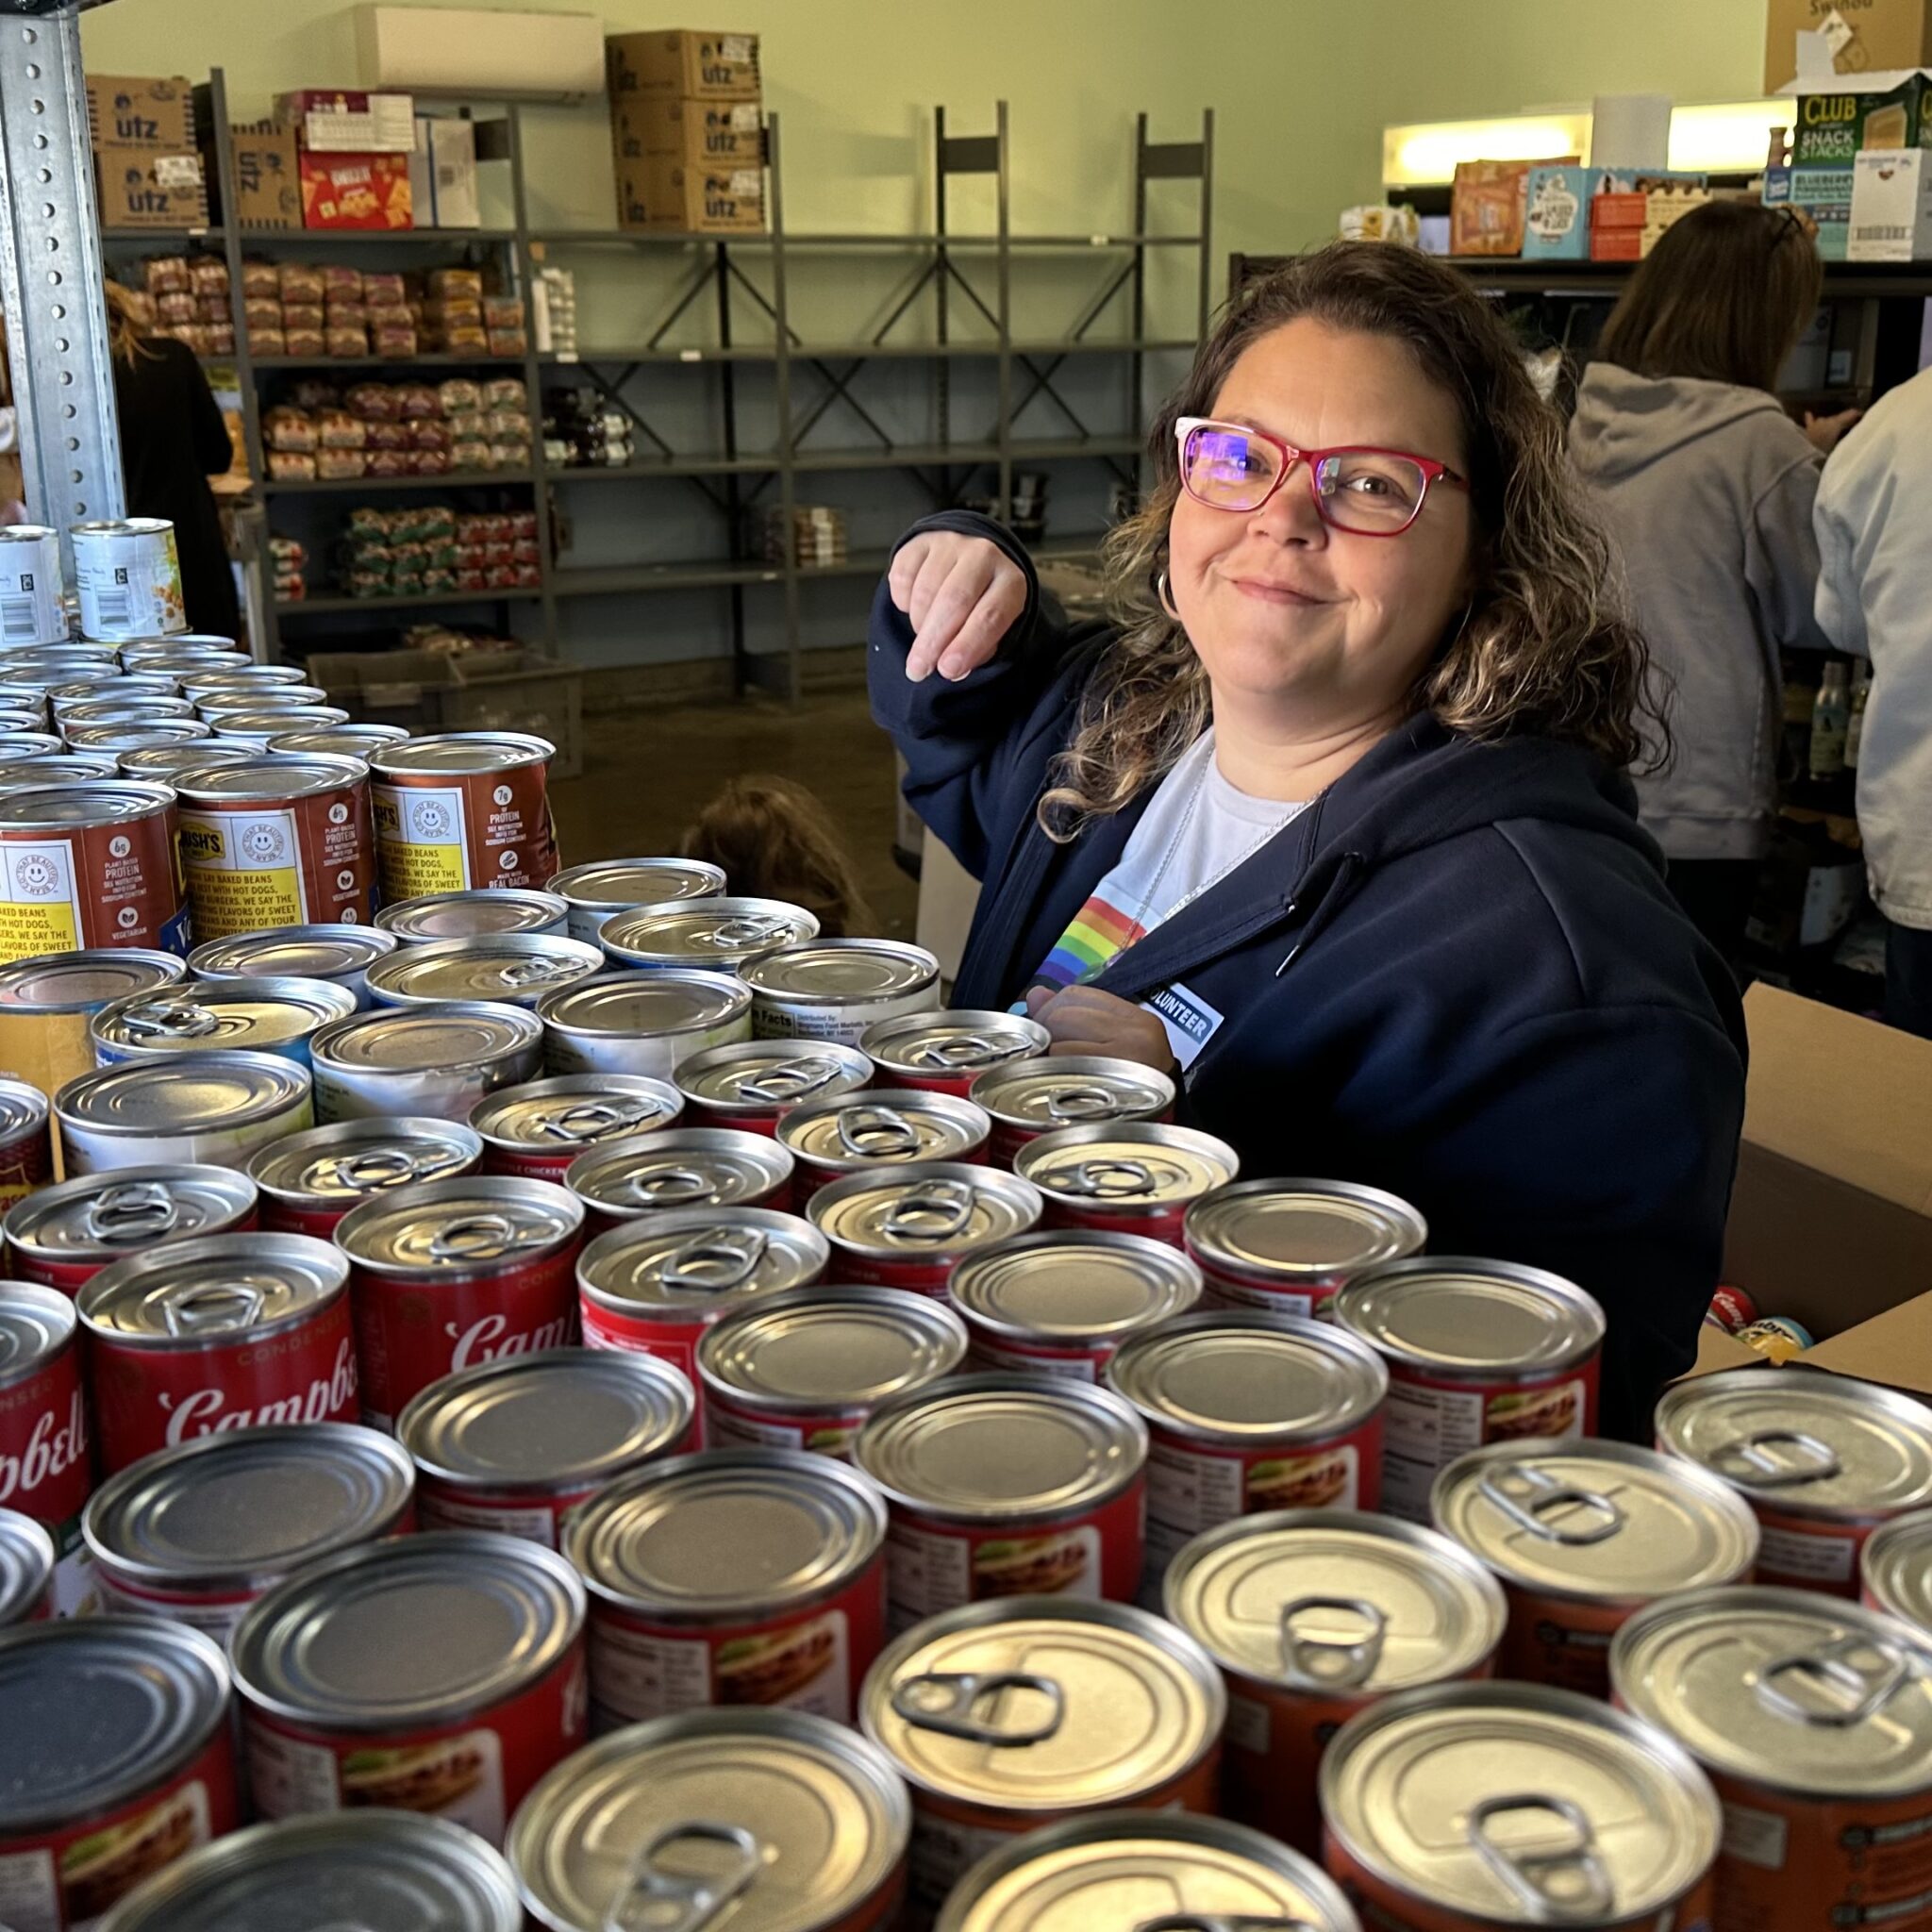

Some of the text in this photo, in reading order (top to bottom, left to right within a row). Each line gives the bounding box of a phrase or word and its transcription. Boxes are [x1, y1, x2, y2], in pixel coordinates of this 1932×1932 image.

[701, 63, 732, 84] utz
[1805, 96, 1857, 125] CLUB
[116, 116, 158, 139] utz
[706, 131, 736, 152] utz
[1802, 130, 1855, 145] SNACK
[1800, 145, 1855, 159] STACKS
[239, 151, 261, 193] utz
[127, 190, 169, 213] utz
[706, 197, 736, 218] utz
[497, 790, 508, 802] 7g
[332, 807, 344, 821] 6g
[490, 810, 520, 824] PROTEIN
[325, 830, 356, 844] PROTEIN
[114, 841, 126, 855] 6g
[405, 858, 419, 867] HOT
[421, 859, 444, 869] DOGS,
[105, 864, 141, 879] PROTEIN
[413, 869, 425, 878] WE
[441, 870, 458, 878] THE
[217, 874, 242, 884] BAKED
[243, 874, 273, 884] BEANS
[424, 879, 433, 888] OF
[435, 879, 460, 888] SWEET
[489, 874, 530, 889] REAL BACON
[233, 886, 249, 894] HOT
[251, 886, 278, 894] DOGS,
[243, 895, 256, 905] WE
[258, 895, 274, 905] SAY
[275, 894, 292, 903] THE
[18, 908, 46, 917] BEANS
[219, 905, 296, 916] FLAVORS OF SWEET
[8, 919, 24, 928] HOT
[25, 920, 53, 929] DOGS,
[222, 917, 238, 926] AND
[240, 917, 256, 926] ANY
[258, 916, 269, 925] OF
[272, 915, 295, 924] YOUR
[19, 930, 30, 940] WE
[32, 931, 48, 940] SAY
[50, 930, 68, 940] THE
[111, 926, 147, 941] VEGETARIAN
[29, 942, 41, 951] OF
[42, 941, 72, 951] SWEET
[762, 1010, 791, 1027] Facts
[1151, 988, 1208, 1038] OLUNTEER
[524, 1165, 566, 1176] CHICKEN
